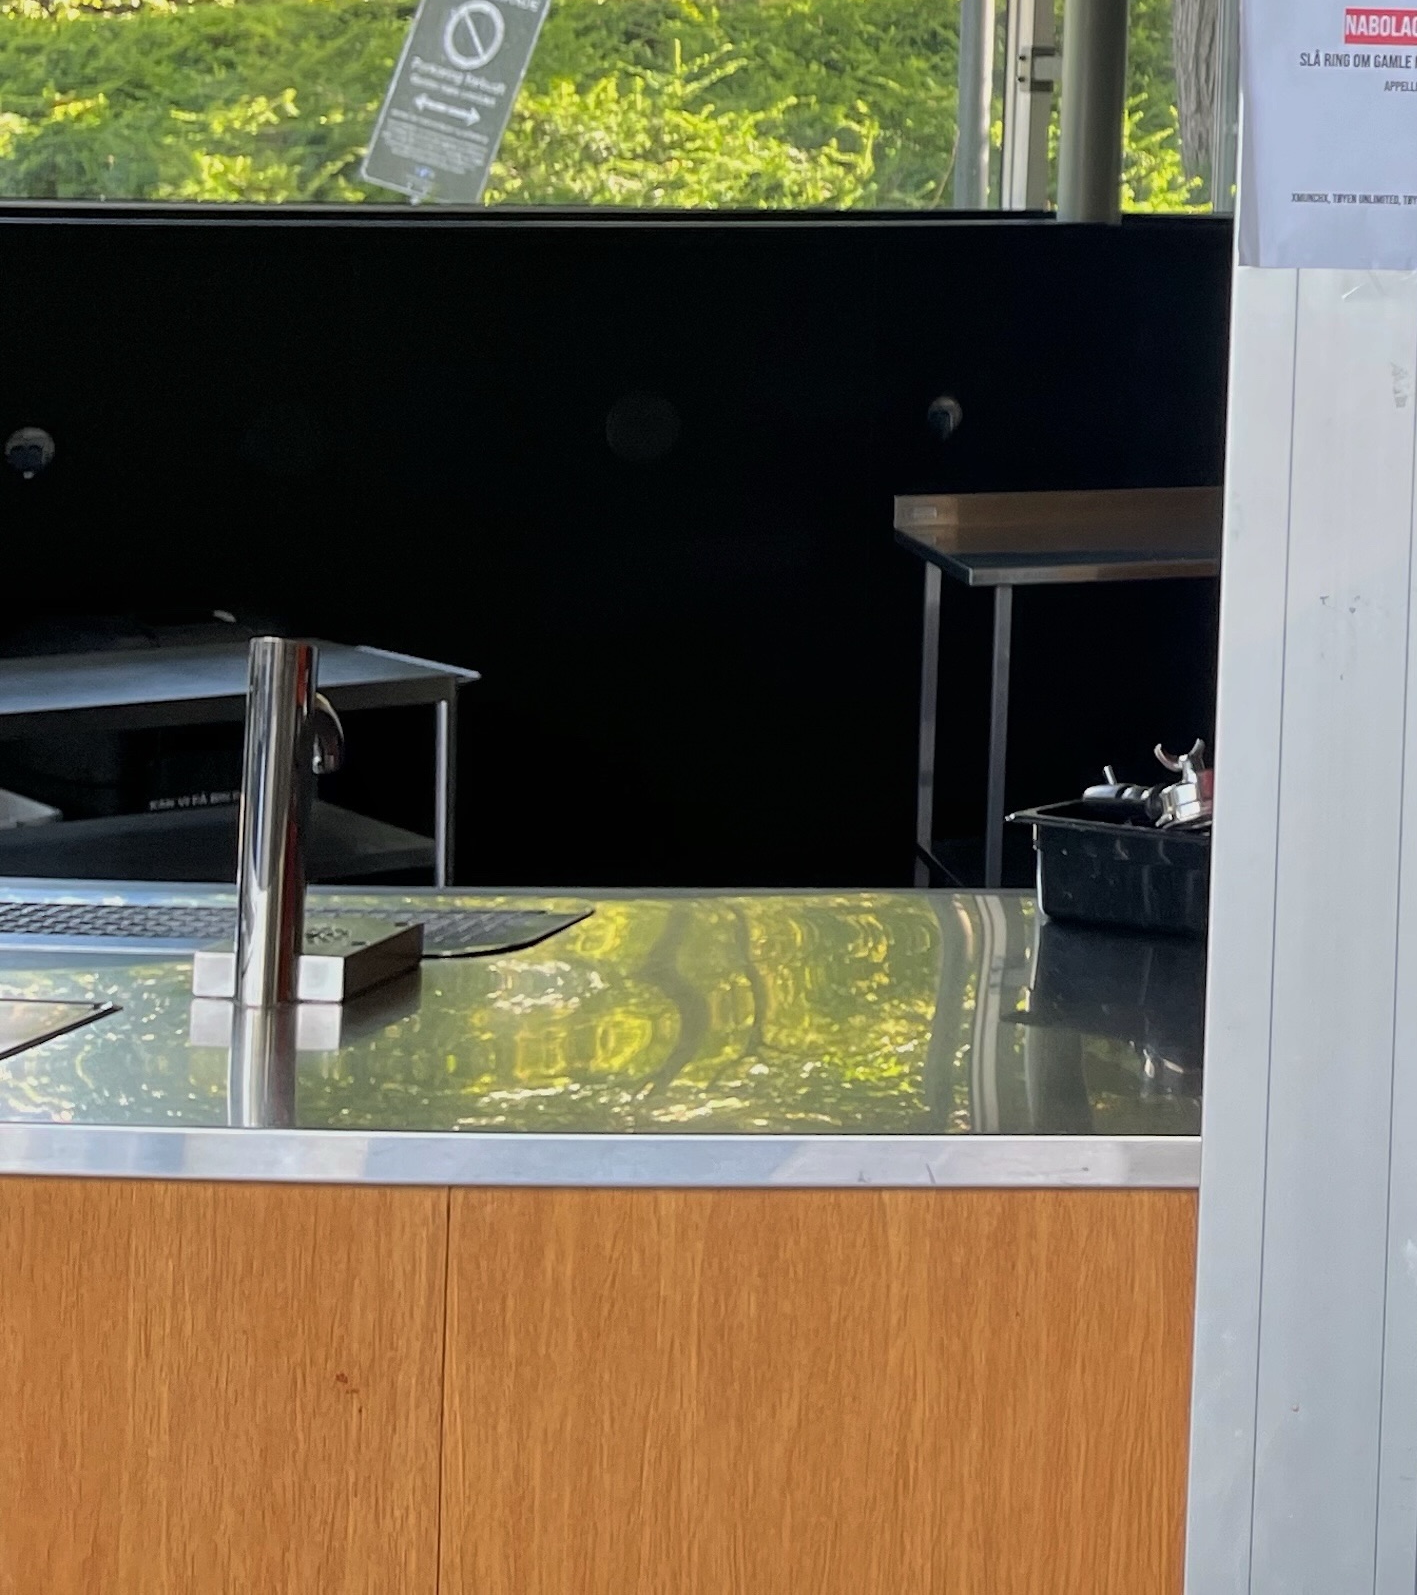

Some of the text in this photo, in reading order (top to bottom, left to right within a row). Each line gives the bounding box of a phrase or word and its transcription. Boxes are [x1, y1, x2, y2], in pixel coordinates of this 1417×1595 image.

[1299, 49, 1321, 67] SLÅ
[1324, 53, 1350, 68] RING
[1353, 54, 1371, 68] OM
[1374, 54, 1411, 69] GAMLE
